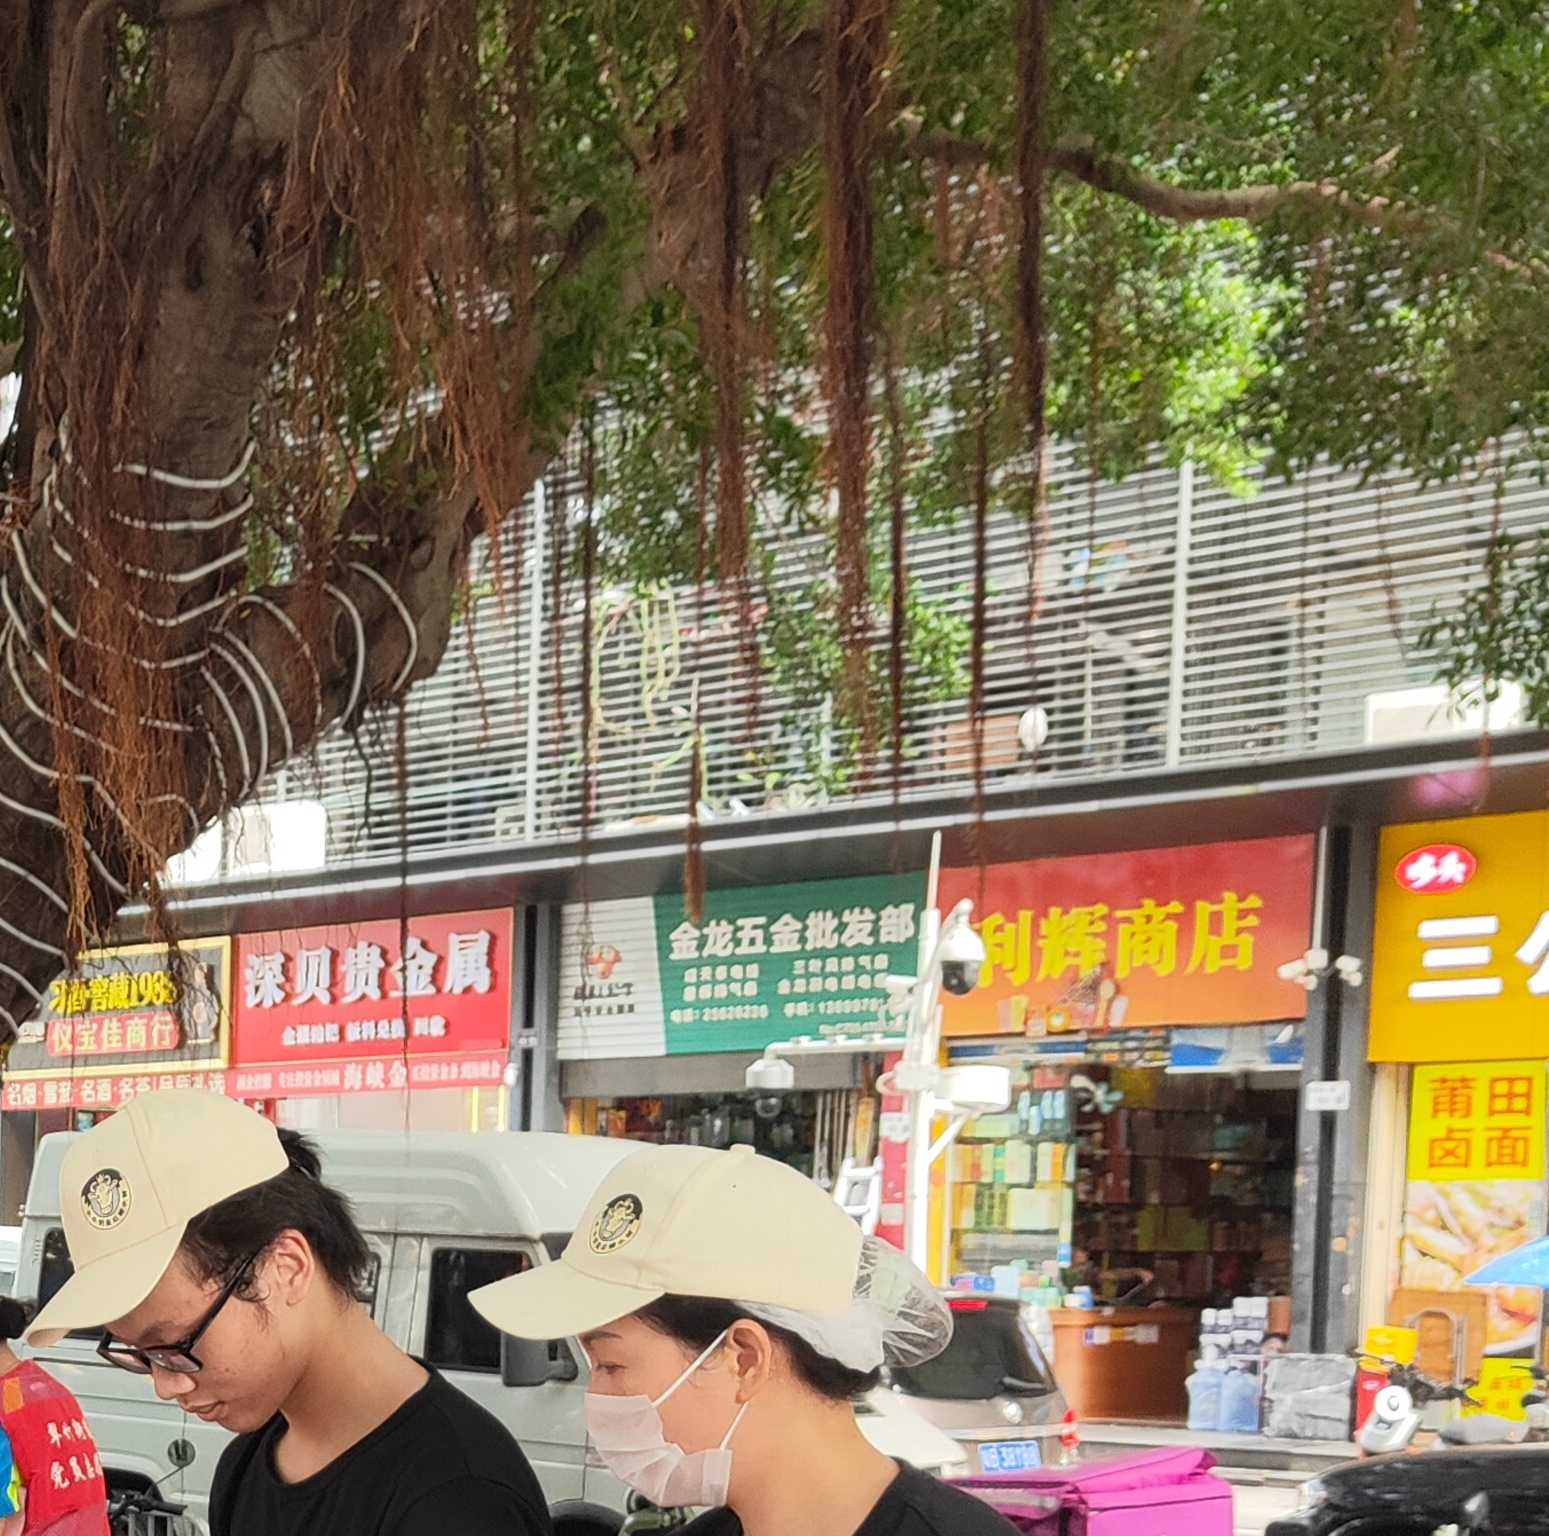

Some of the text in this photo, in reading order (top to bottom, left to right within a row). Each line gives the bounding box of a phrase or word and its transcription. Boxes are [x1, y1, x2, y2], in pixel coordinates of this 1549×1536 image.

[668, 903, 915, 961] 金龙五金批发部
[978, 891, 1262, 987] 利辉商店
[244, 928, 493, 1009] 深贝贵金属
[51, 1014, 175, 1054] 仪宝佳商行
[1429, 1074, 1534, 1121] 莆田
[1426, 1127, 1531, 1172] 卤面
[47, 1418, 96, 1449] 翠竹街
[50, 1452, 103, 1490] 党员志
